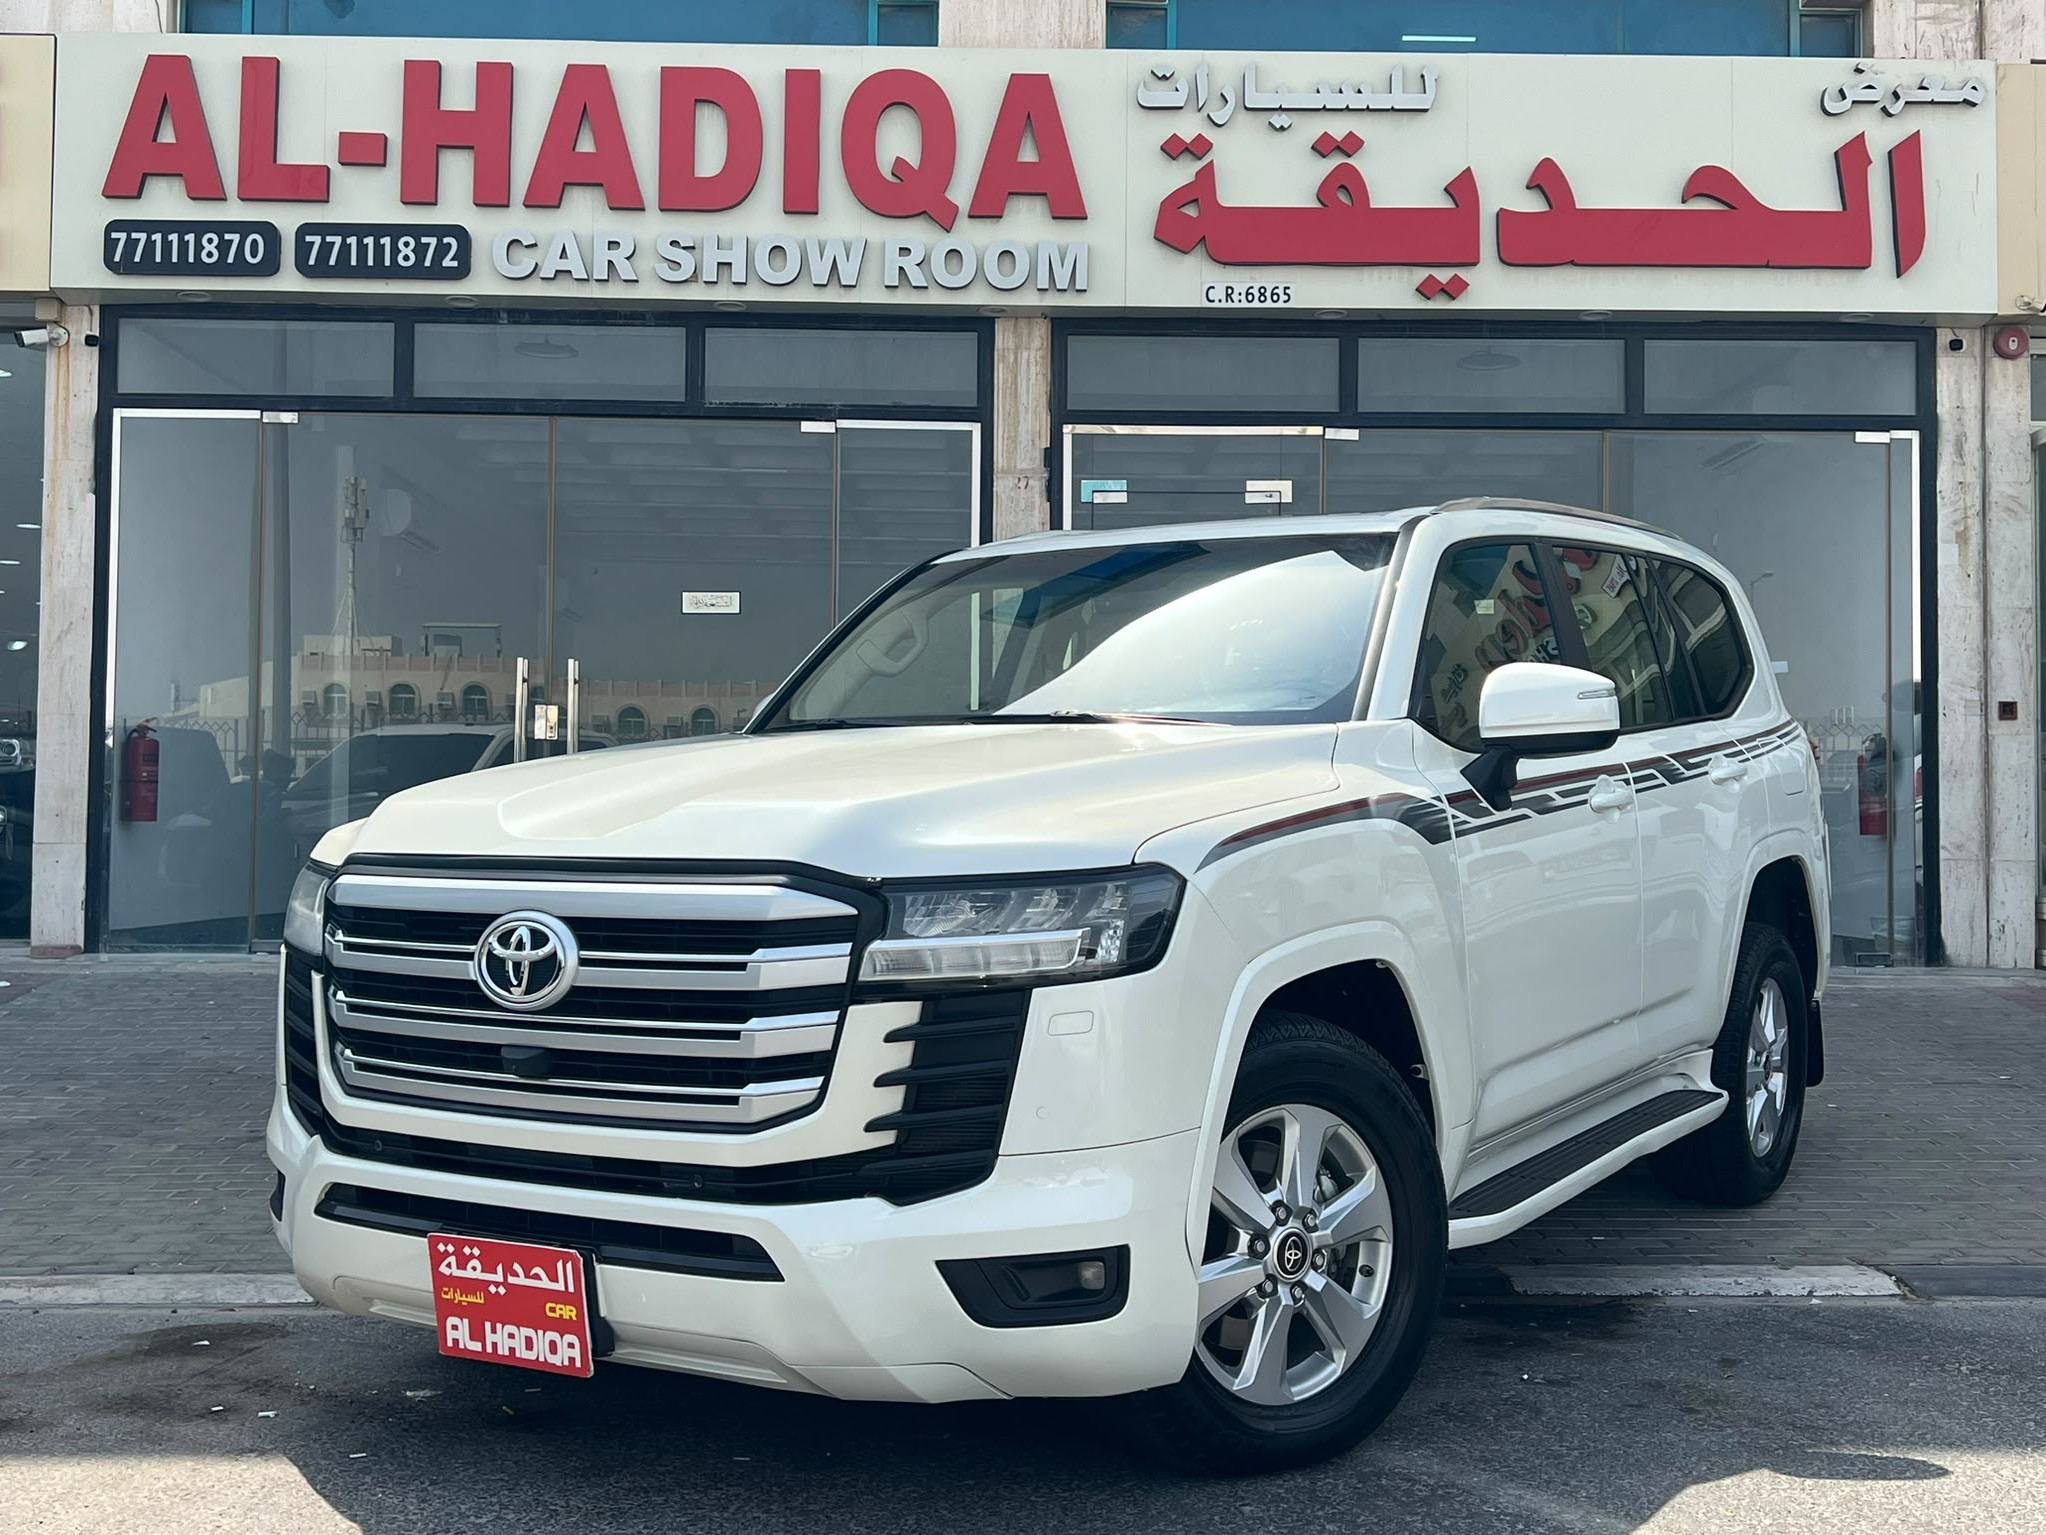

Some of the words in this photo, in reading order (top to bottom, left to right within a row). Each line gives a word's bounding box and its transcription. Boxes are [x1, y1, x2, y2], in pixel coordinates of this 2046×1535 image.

[1137, 63, 1439, 131] للسيارات
[1820, 62, 1986, 117] معرض
[102, 54, 1088, 232] AL-HADIQA
[1154, 129, 1927, 301] الحديقة
[110, 231, 265, 265] 77111870
[304, 235, 460, 269] 77111872
[492, 229, 638, 283] CAR
[654, 231, 867, 287] SHOW
[884, 238, 1089, 291] ROOM
[1204, 284, 1292, 305] C.R:6865
[437, 1243, 574, 1295] الحديقة
[441, 1287, 485, 1306] للسيارات
[545, 1302, 578, 1321] CAR
[445, 1316, 483, 1352] AL
[484, 1321, 582, 1368] HADIQA
